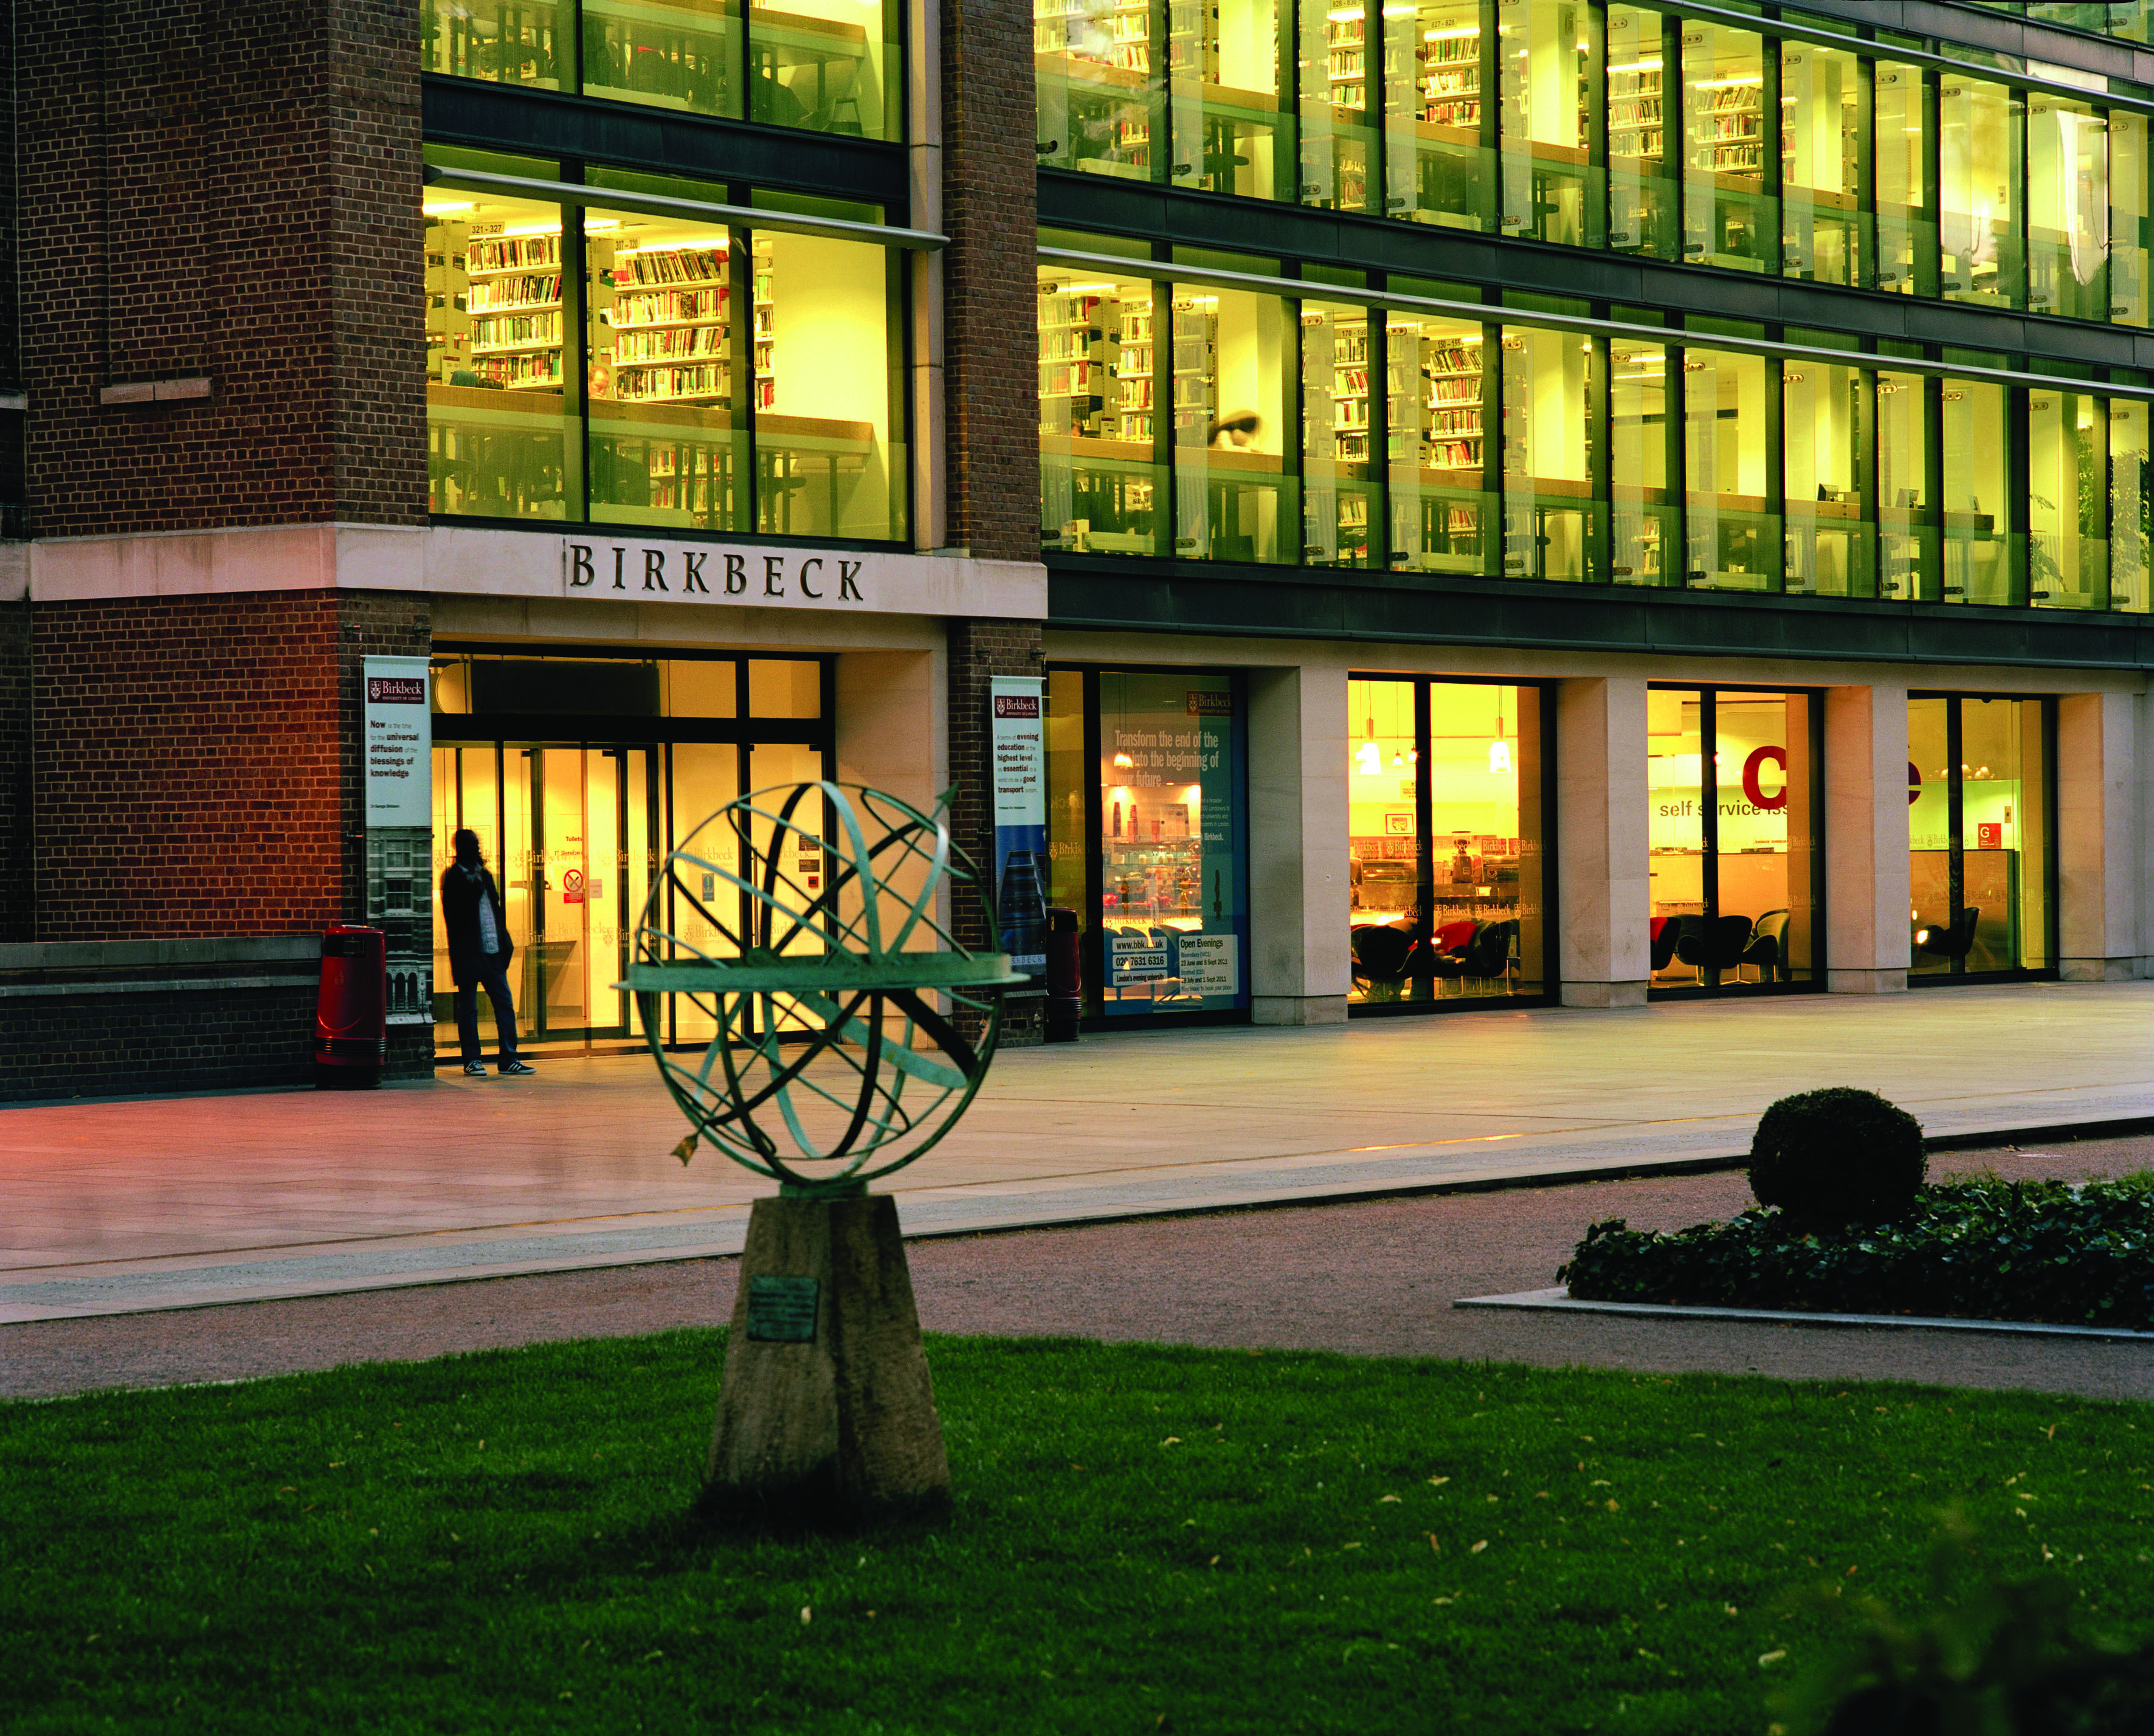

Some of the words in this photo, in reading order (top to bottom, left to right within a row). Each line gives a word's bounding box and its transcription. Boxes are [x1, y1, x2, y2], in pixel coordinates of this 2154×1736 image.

[472, 225, 485, 234] 321
[489, 224, 502, 233] 327
[615, 240, 624, 250] 307
[1437, 340, 1446, 349] 150
[569, 544, 864, 602] BIRKBECK
[382, 681, 422, 694] Birkbeck
[1006, 698, 1037, 710] Birkbeck
[1199, 694, 1232, 707] Birkbeck
[370, 720, 386, 729] Now
[386, 732, 419, 741] universal
[1017, 732, 1039, 742] evening
[1115, 729, 1156, 747] Transform
[1159, 731, 1173, 748] the
[1175, 731, 1191, 748] end
[1193, 731, 1201, 748] of
[1204, 731, 1218, 748] the
[370, 744, 403, 753] diffusion
[370, 757, 404, 767] blessings
[406, 757, 414, 765] of
[997, 753, 1018, 763] highest
[1020, 753, 1033, 762] level
[1133, 750, 1148, 767] into
[1150, 750, 1164, 767] the
[1167, 750, 1207, 771] beginning
[1210, 751, 1219, 767] of
[370, 768, 409, 779] knowledge
[1003, 764, 1029, 773] essential
[1023, 775, 1037, 784] good
[1136, 770, 1162, 788] future
[998, 785, 1024, 794] transport
[1660, 800, 1692, 816] self
[1697, 799, 1761, 816] srvice
[1980, 827, 1990, 838] G
[1395, 839, 1423, 852] Birkbeck
[782, 845, 809, 858] kbeck
[1443, 904, 1471, 916] Birkbeck
[1483, 903, 1511, 916] Birkbeck
[1117, 940, 1163, 949] www.bbk..uk
[1181, 939, 1196, 950] Open
[1197, 939, 1224, 949] Evenings
[1011, 955, 1043, 965] RKBECK
[1130, 956, 1147, 966] 7631
[1148, 956, 1164, 965] 6316
[1116, 974, 1133, 982] London's
[1133, 973, 1147, 983] evening
